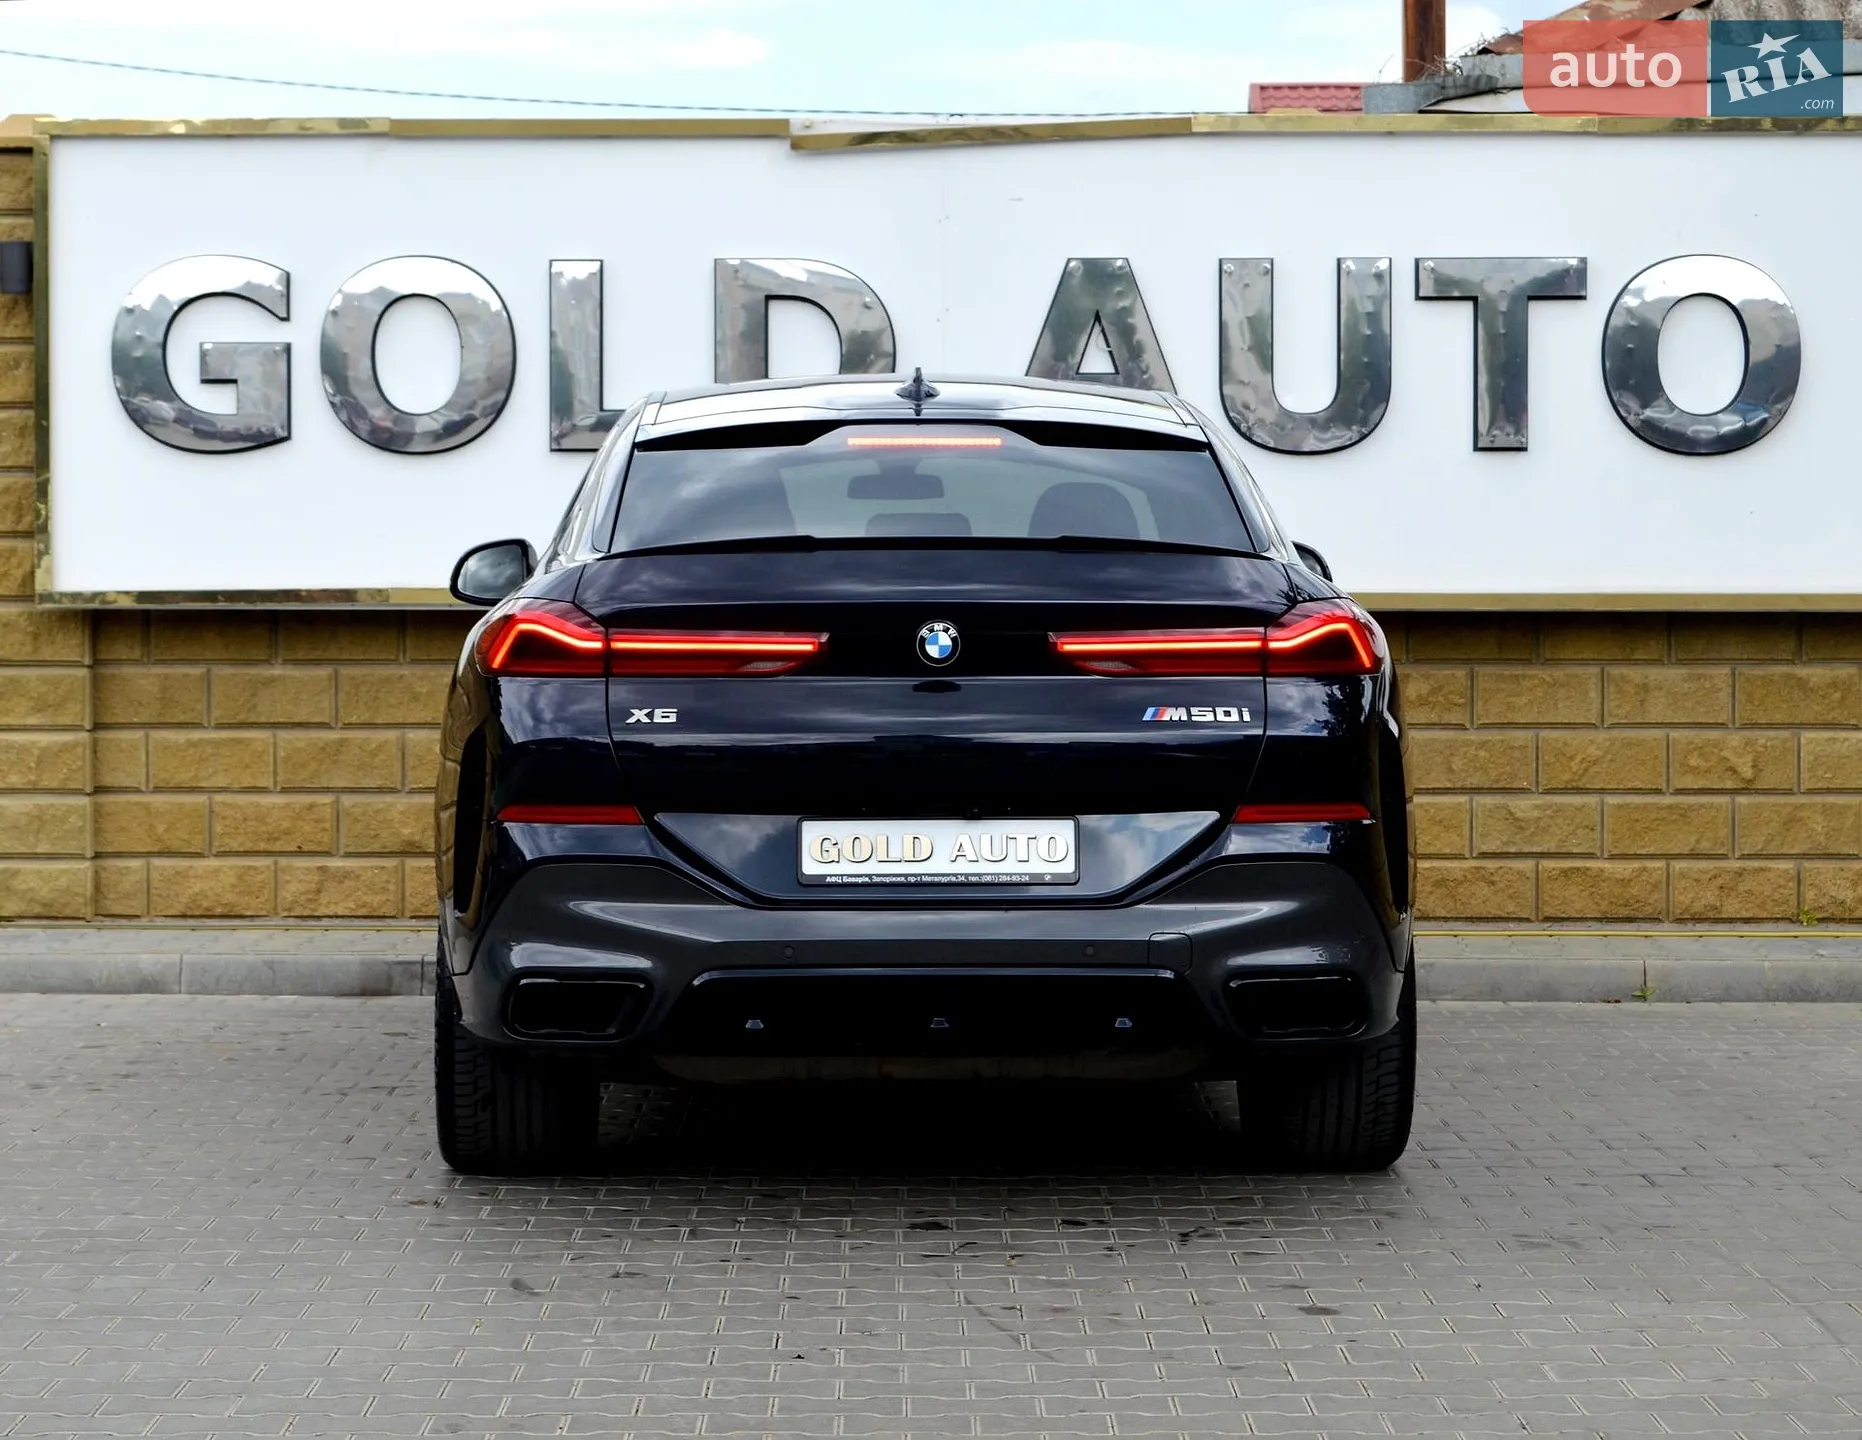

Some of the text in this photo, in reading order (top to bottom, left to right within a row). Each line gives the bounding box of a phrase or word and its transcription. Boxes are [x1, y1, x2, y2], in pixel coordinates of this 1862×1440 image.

[111, 253, 1803, 455] GOLD AUTO
[920, 624, 958, 639] BMW
[625, 708, 678, 724] X6
[1160, 706, 1251, 722] M50i
[809, 832, 1069, 864] GOLD AUTO
